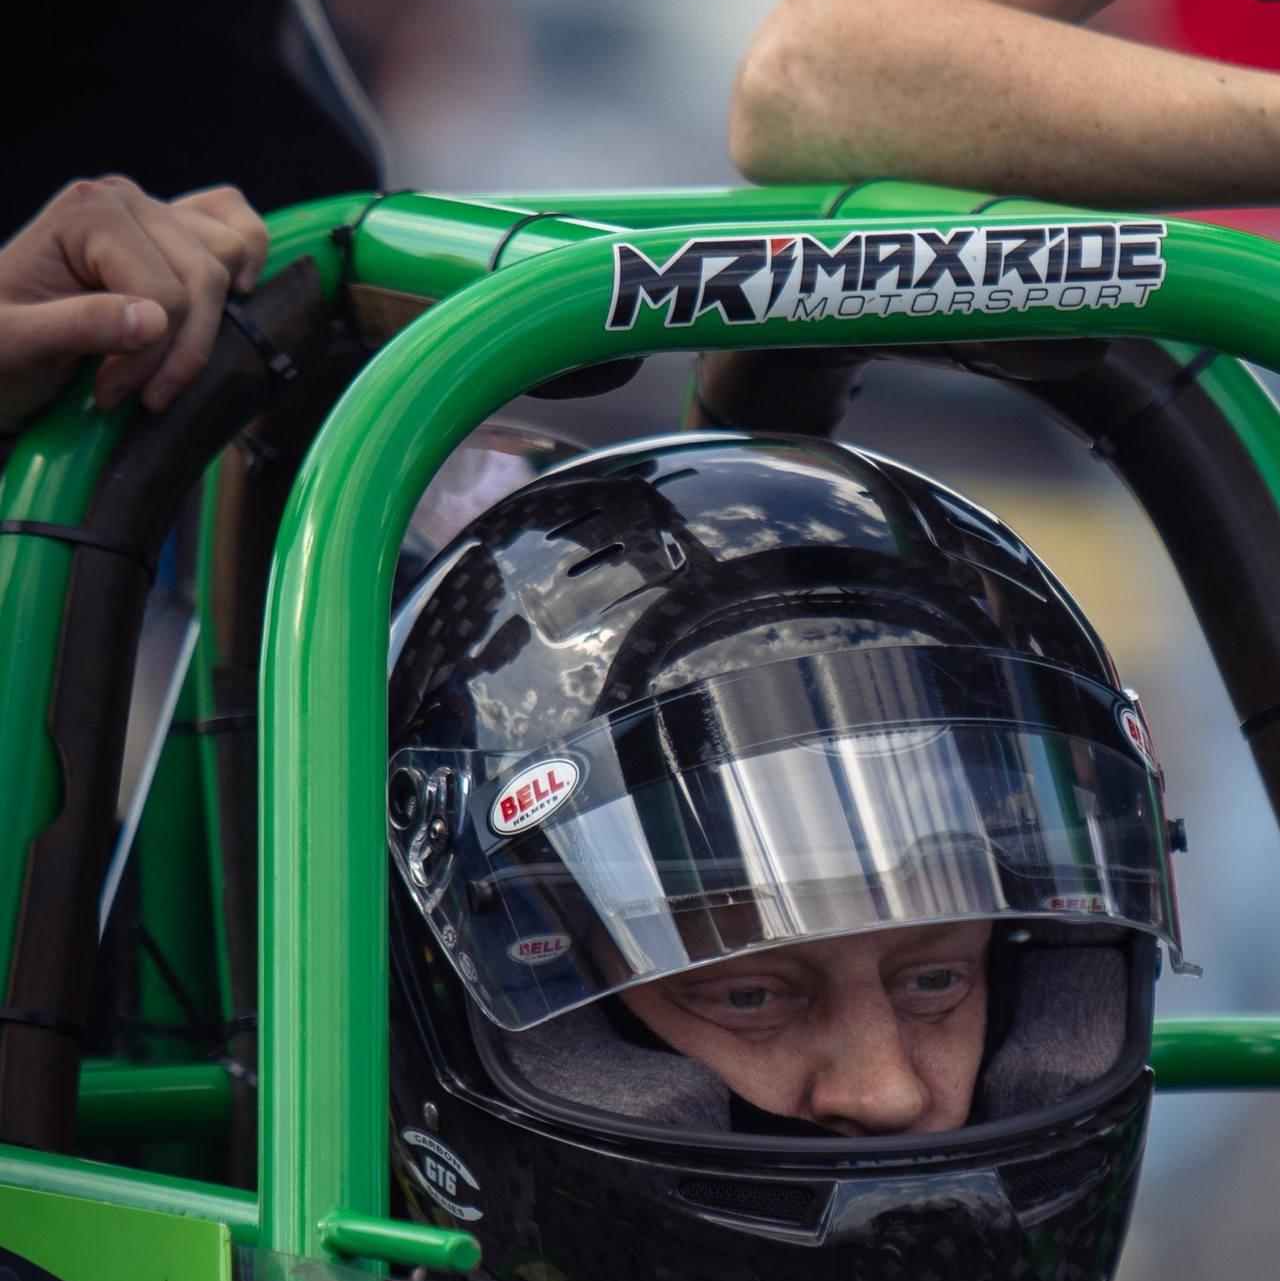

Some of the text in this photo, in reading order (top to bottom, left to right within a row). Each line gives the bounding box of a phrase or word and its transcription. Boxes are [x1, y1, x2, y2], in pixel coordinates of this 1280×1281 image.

[791, 283, 1153, 322] MOTORSPORT
[499, 769, 566, 825] BELL
[513, 795, 559, 827] HELMETS
[414, 1133, 461, 1172] CARBON
